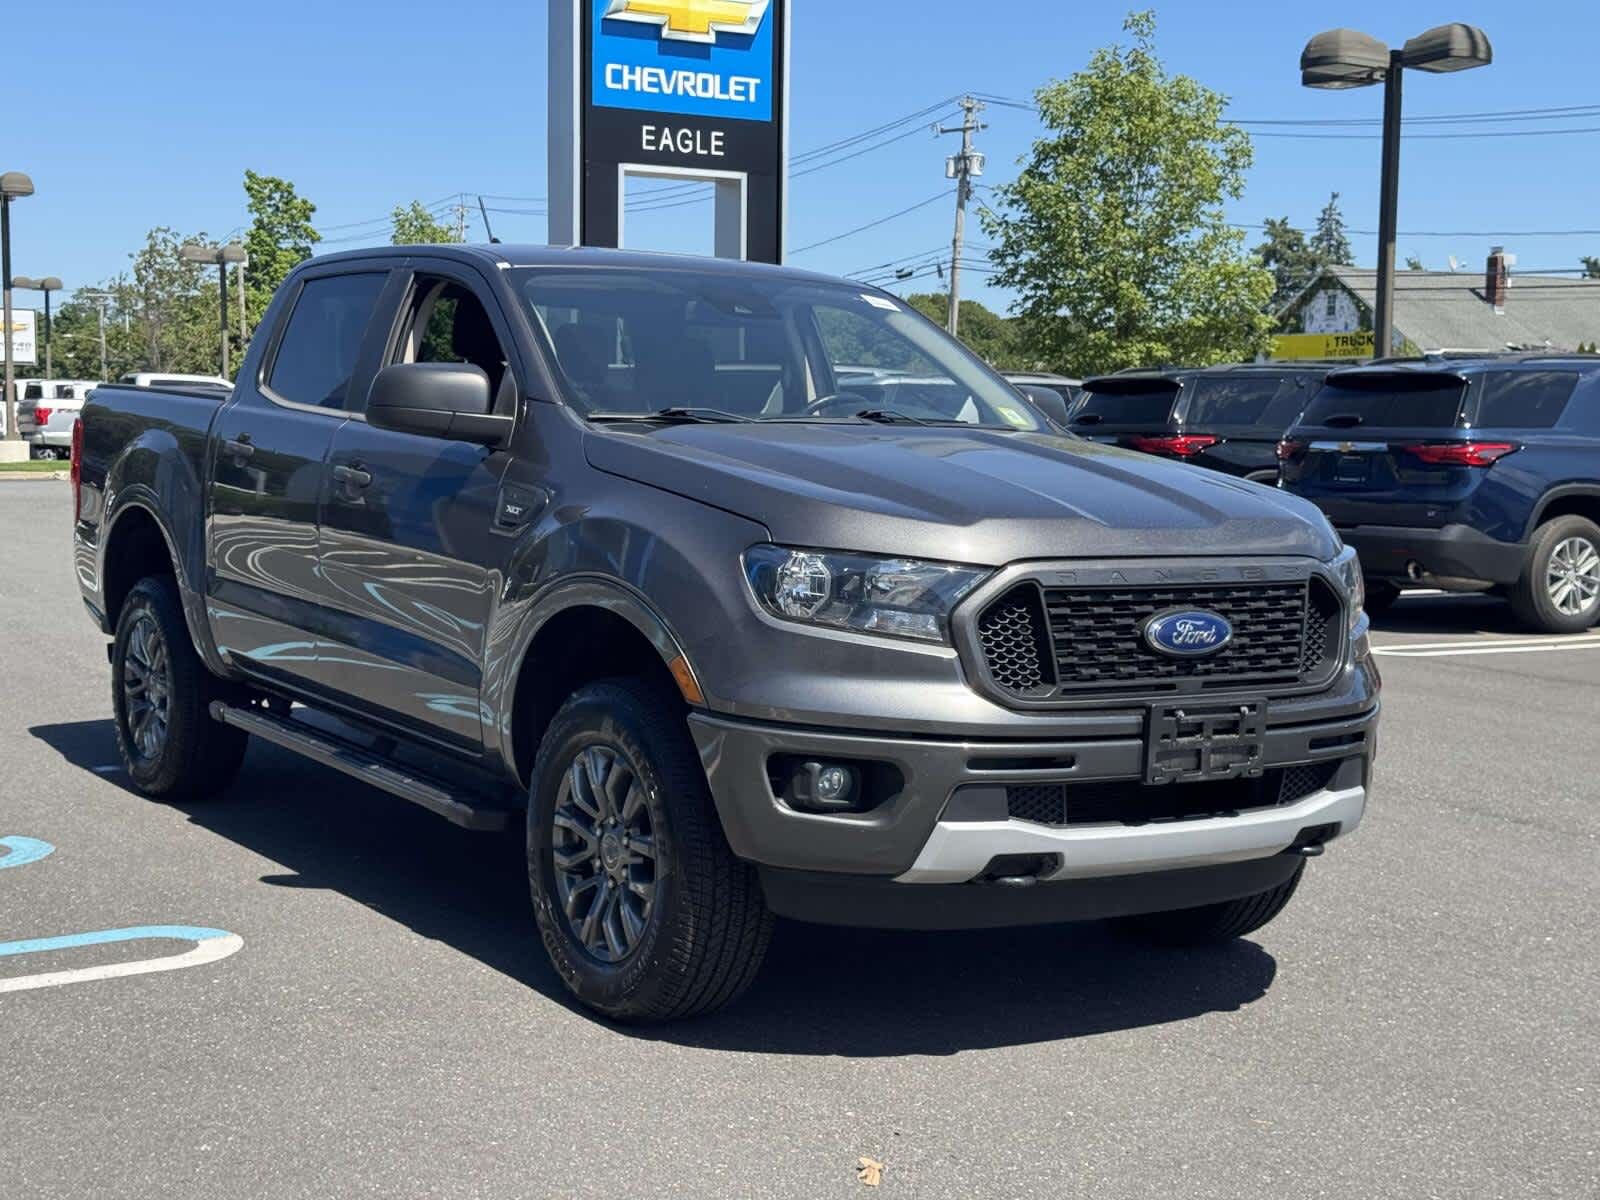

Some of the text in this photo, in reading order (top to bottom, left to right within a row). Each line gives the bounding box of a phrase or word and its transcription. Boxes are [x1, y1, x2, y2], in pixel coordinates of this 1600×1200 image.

[605, 63, 760, 102] CHEVROLET
[642, 125, 725, 156] EAGLE
[1172, 619, 1217, 645] Ford
